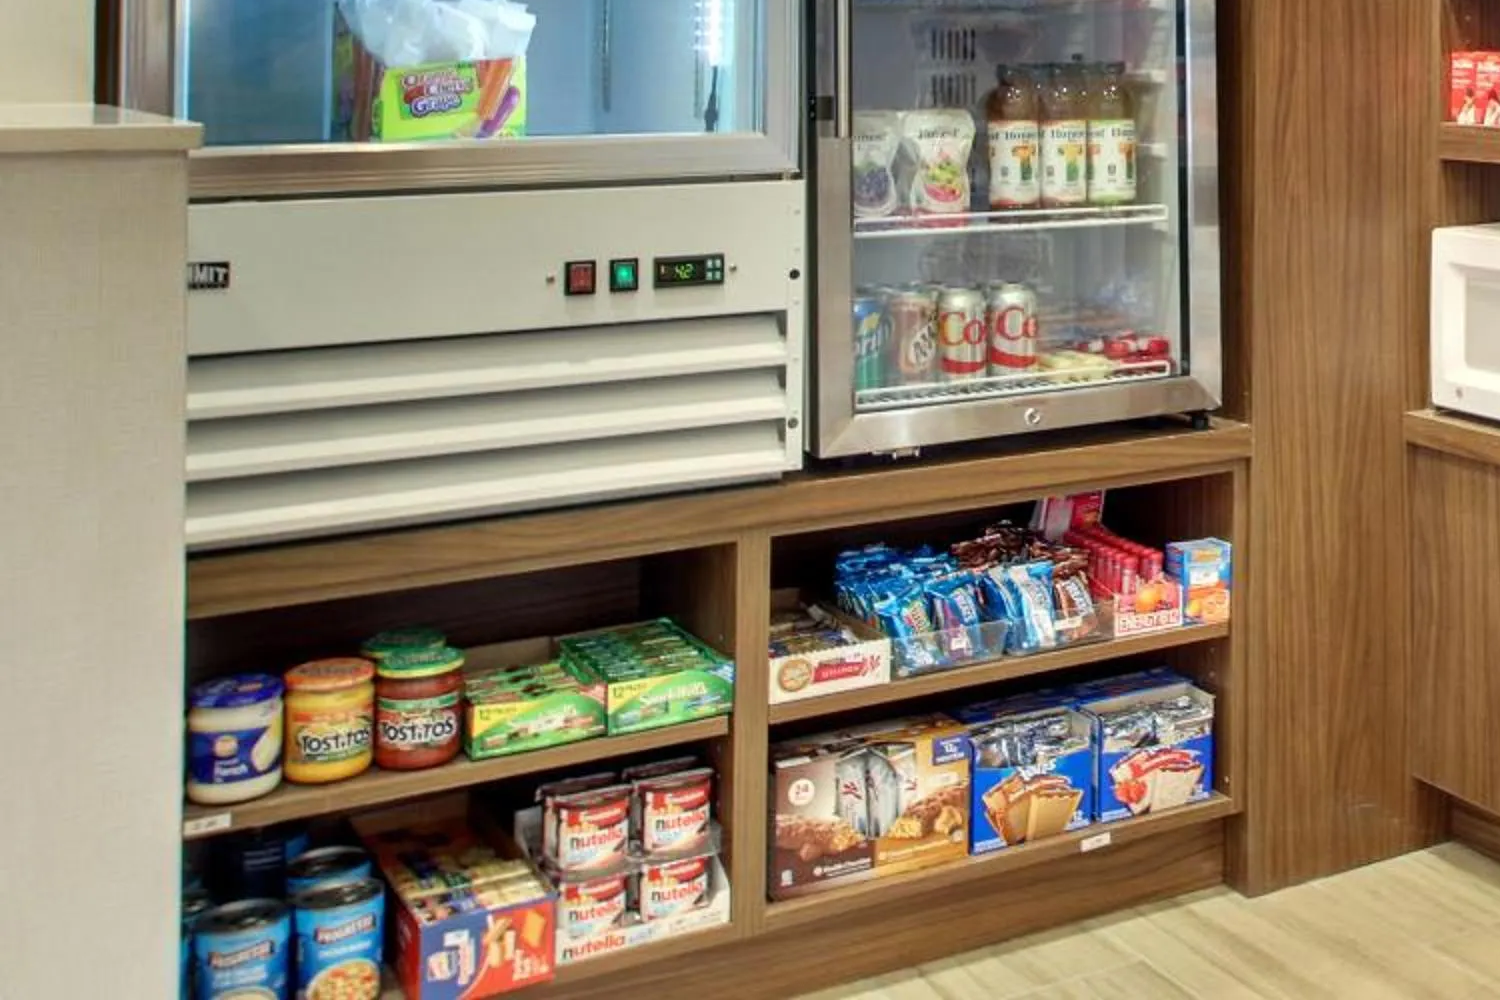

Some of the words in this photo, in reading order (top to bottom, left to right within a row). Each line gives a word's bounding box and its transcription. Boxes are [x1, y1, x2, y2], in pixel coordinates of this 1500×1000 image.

[655, 810, 707, 833] nutella
[569, 828, 623, 851] nutella
[651, 882, 704, 902] nutella
[567, 901, 622, 923] nutella
[561, 934, 627, 960] nutella
